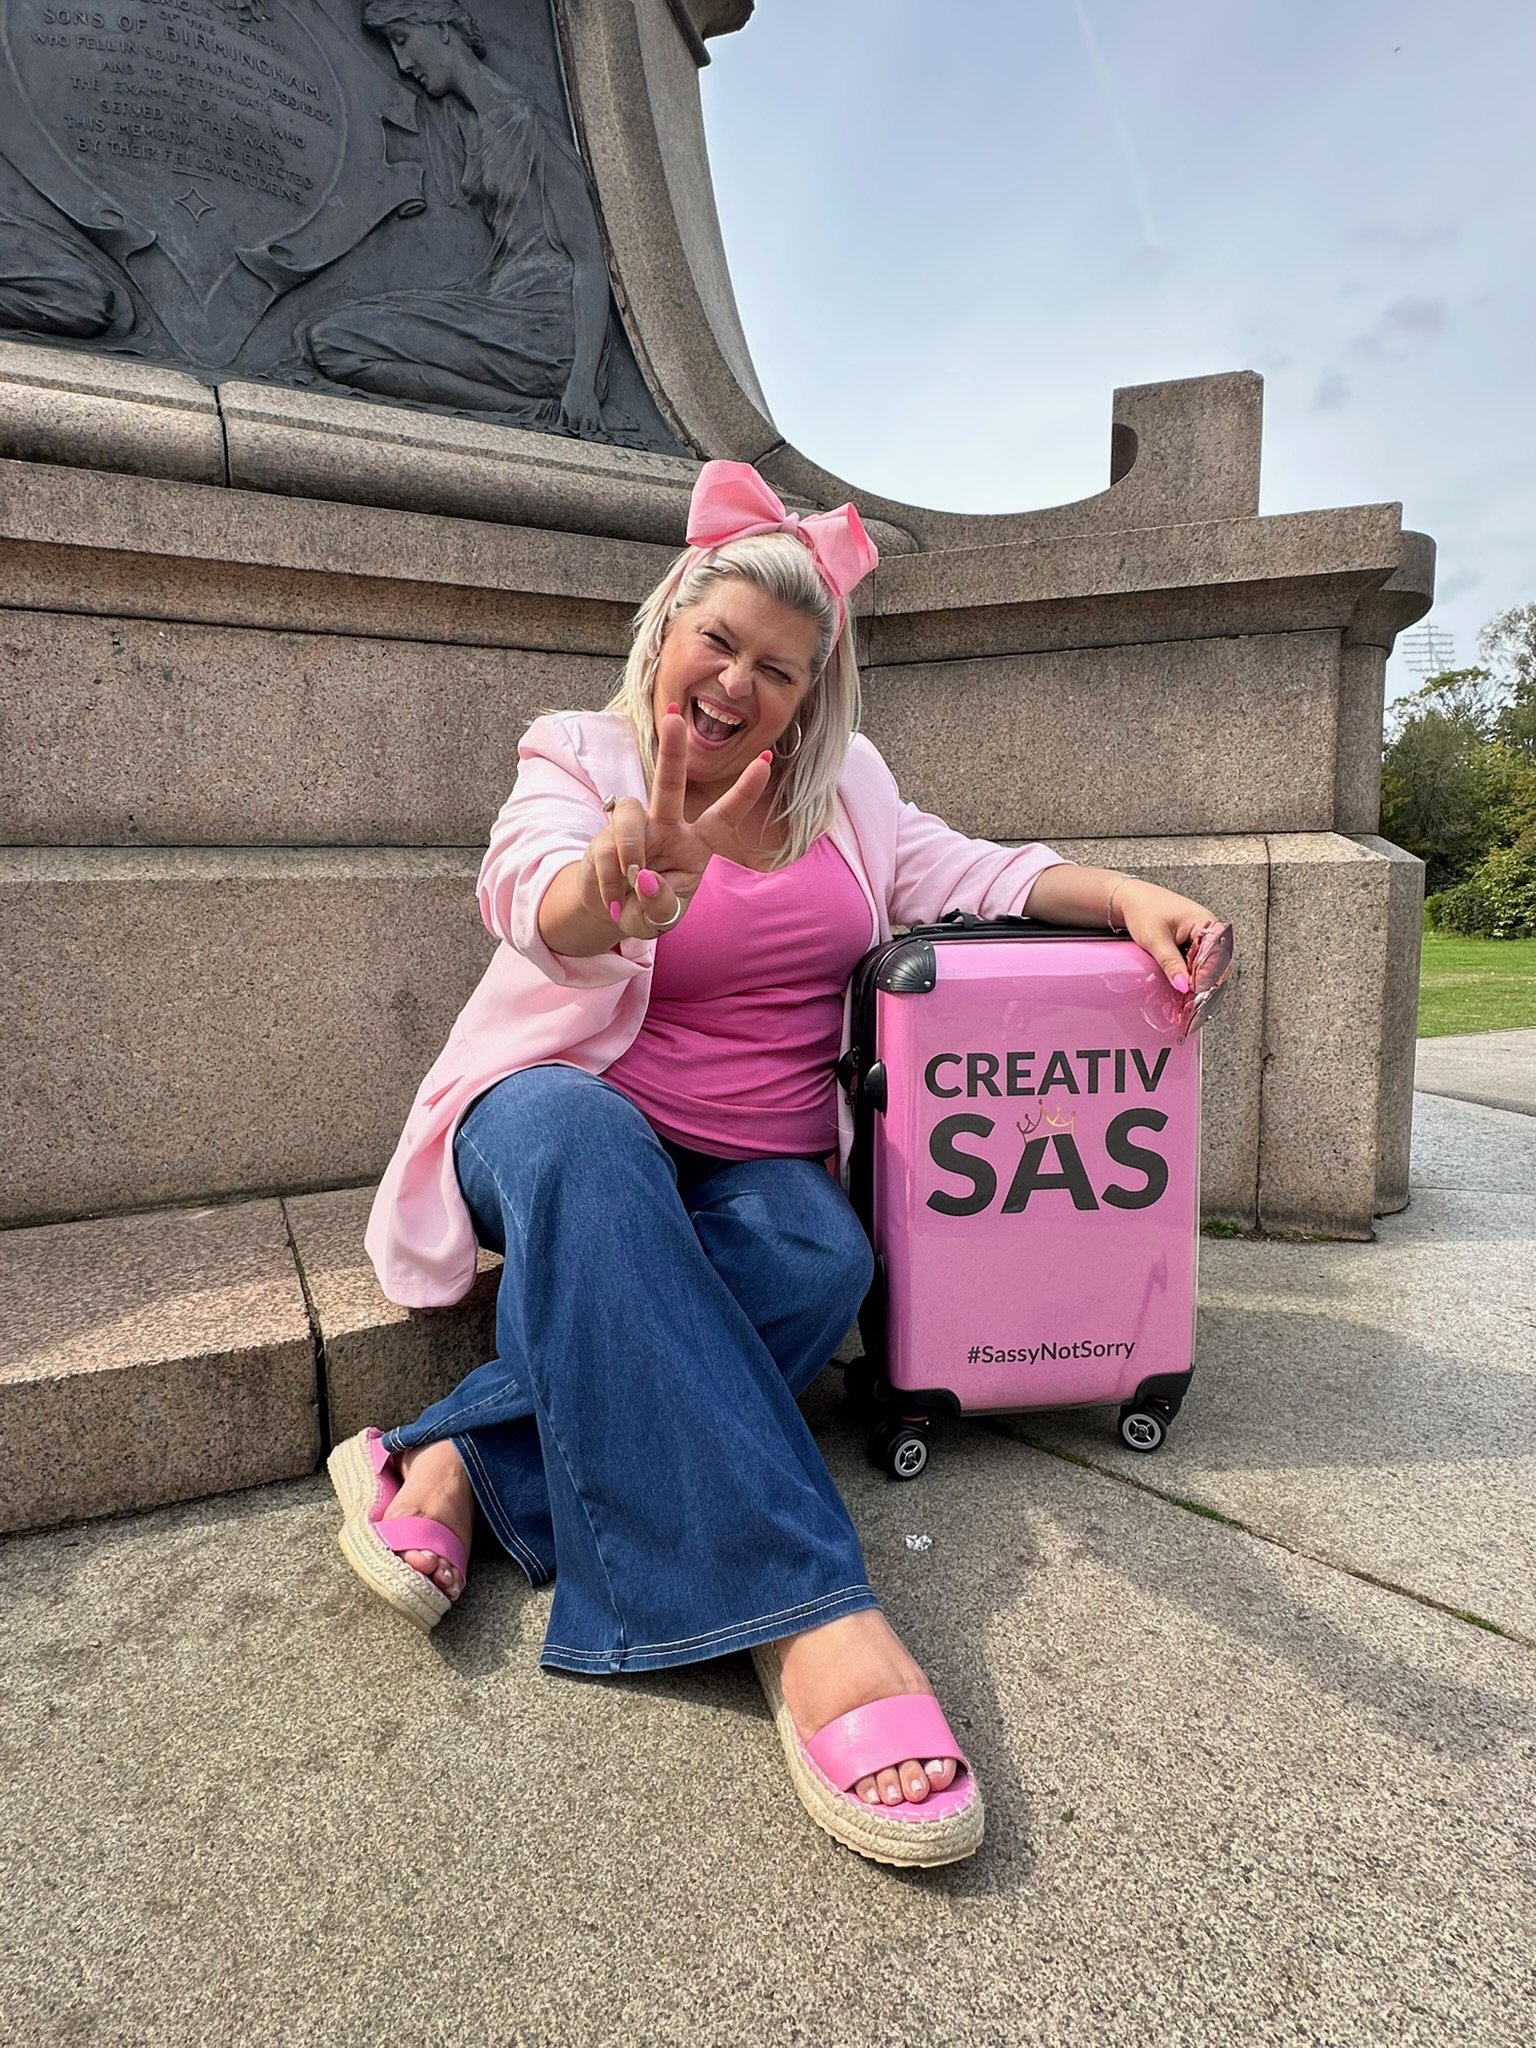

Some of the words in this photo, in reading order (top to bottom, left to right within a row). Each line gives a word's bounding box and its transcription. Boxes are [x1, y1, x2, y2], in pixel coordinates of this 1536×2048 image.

[157, 9, 181, 21] OF
[31, 32, 70, 48] WHO
[76, 35, 117, 52] FELL
[119, 37, 138, 56] IN
[143, 44, 199, 71] SOUTH
[43, 8, 104, 29] SONS
[117, 15, 148, 34] OF
[163, 25, 321, 101] BIRMINGHAM
[71, 76, 100, 92] THE
[115, 80, 188, 105] EXAMPLE
[200, 100, 218, 113] OF
[271, 125, 305, 149] WHO
[102, 60, 135, 75] AND
[144, 67, 164, 81] TO
[176, 71, 272, 117] PERPETUATE
[101, 99, 164, 121] SERVED
[172, 112, 190, 127] IN
[198, 117, 235, 141] THE
[64, 114, 105, 133] THIS
[117, 121, 208, 151] MEMORIAL
[216, 141, 234, 160] IS
[243, 151, 314, 190] ERECTED
[78, 139, 100, 154] BY
[108, 141, 157, 160] THEIR
[924, 1047, 1172, 1099] CREATIV
[926, 1108, 1168, 1216] SAS
[967, 1340, 1136, 1365] #SassyNotSorry
